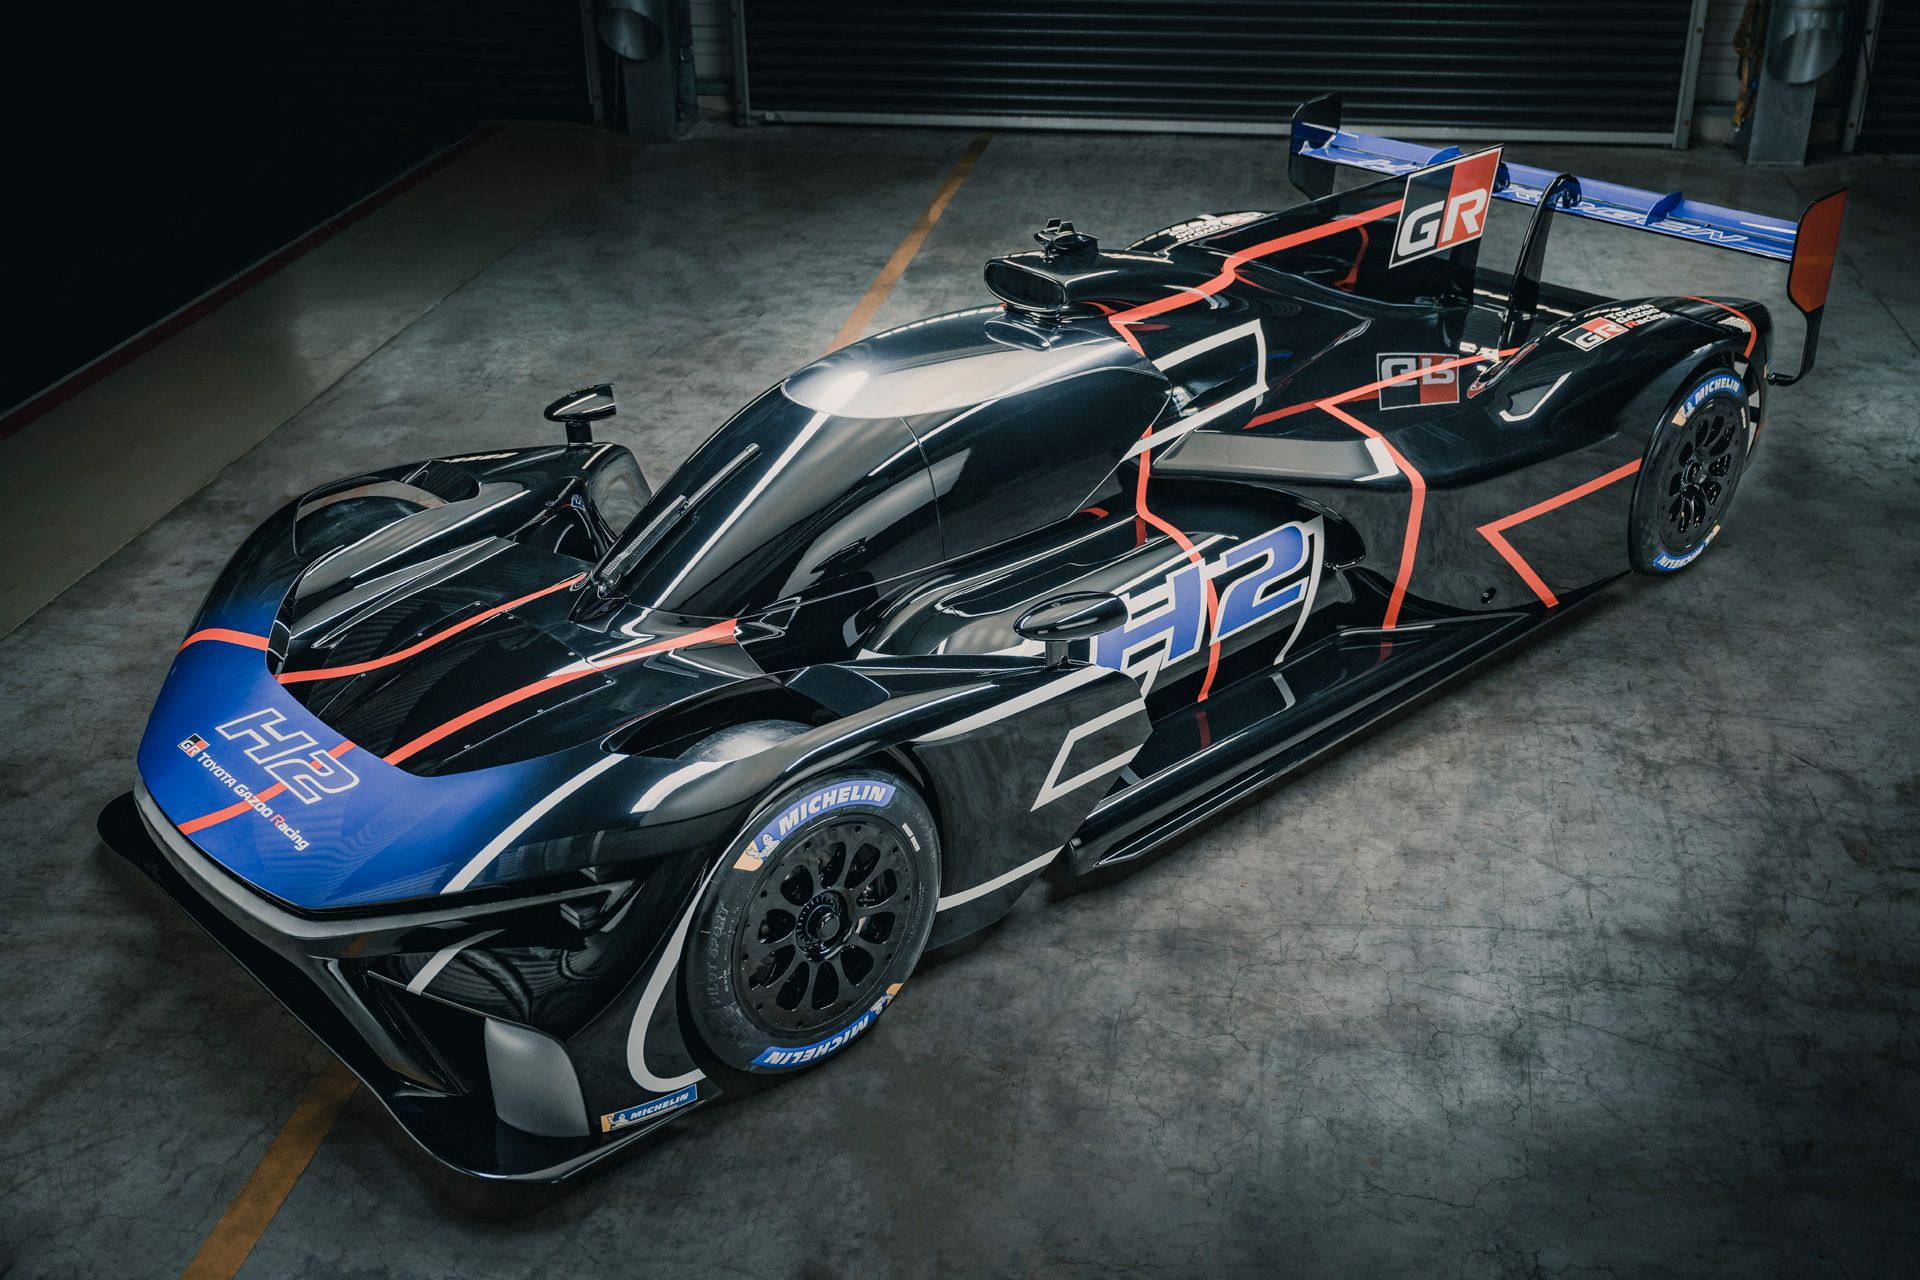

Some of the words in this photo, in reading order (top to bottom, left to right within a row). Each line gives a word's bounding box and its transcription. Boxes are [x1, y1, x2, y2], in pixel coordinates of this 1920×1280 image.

[1398, 188, 1488, 257] GR
[1695, 378, 1740, 403] MICHELIN
[1090, 521, 1310, 671] H2
[214, 707, 360, 805] H2
[197, 751, 237, 788] TOYOTA
[233, 783, 274, 818] GAZOO
[270, 813, 311, 851] Racing
[778, 784, 886, 835] MICHELIN
[762, 1015, 869, 1065] MICHELIN
[630, 1092, 689, 1120] MICHELIN
